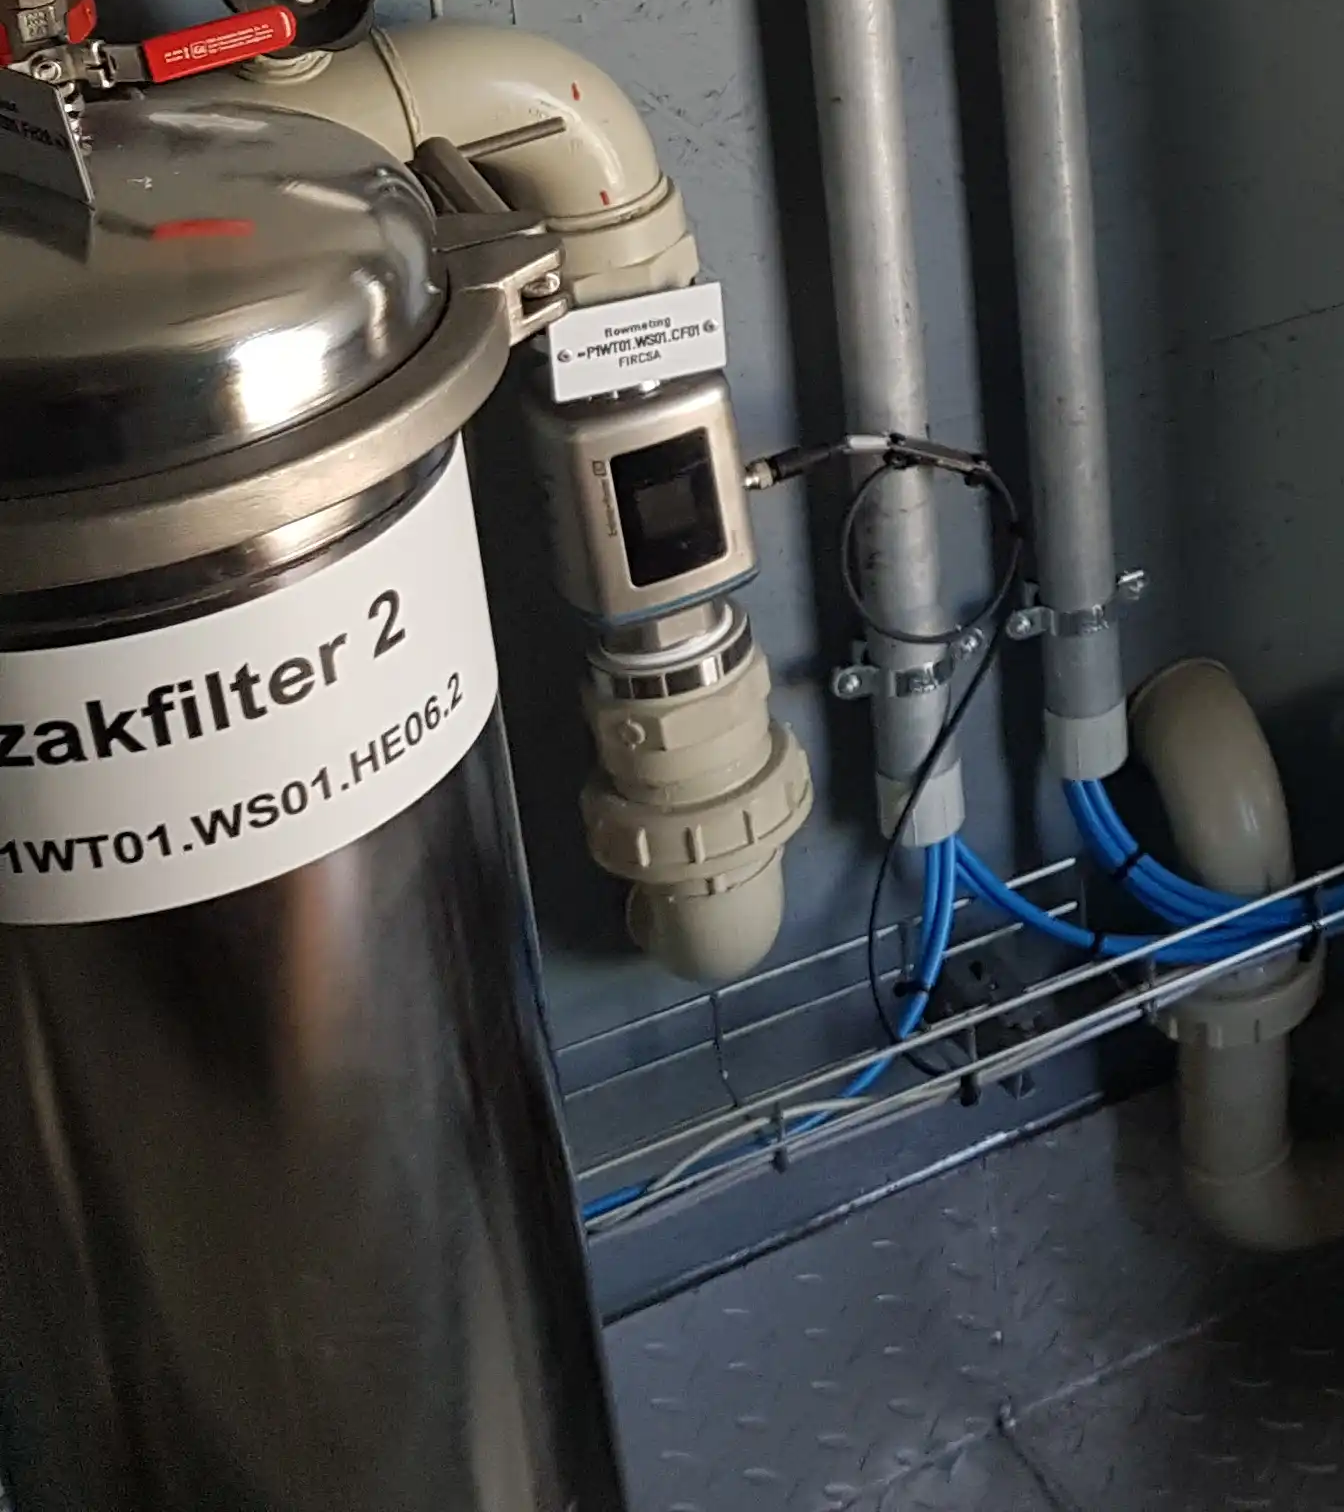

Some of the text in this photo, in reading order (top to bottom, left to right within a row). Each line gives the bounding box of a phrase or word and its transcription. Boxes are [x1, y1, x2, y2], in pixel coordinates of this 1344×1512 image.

[577, 324, 701, 359] =P1WT01.WS01.CF01
[604, 317, 671, 338] flowmeting
[618, 349, 662, 368] FIRCSA
[0, 588, 407, 767] zakfilter 2
